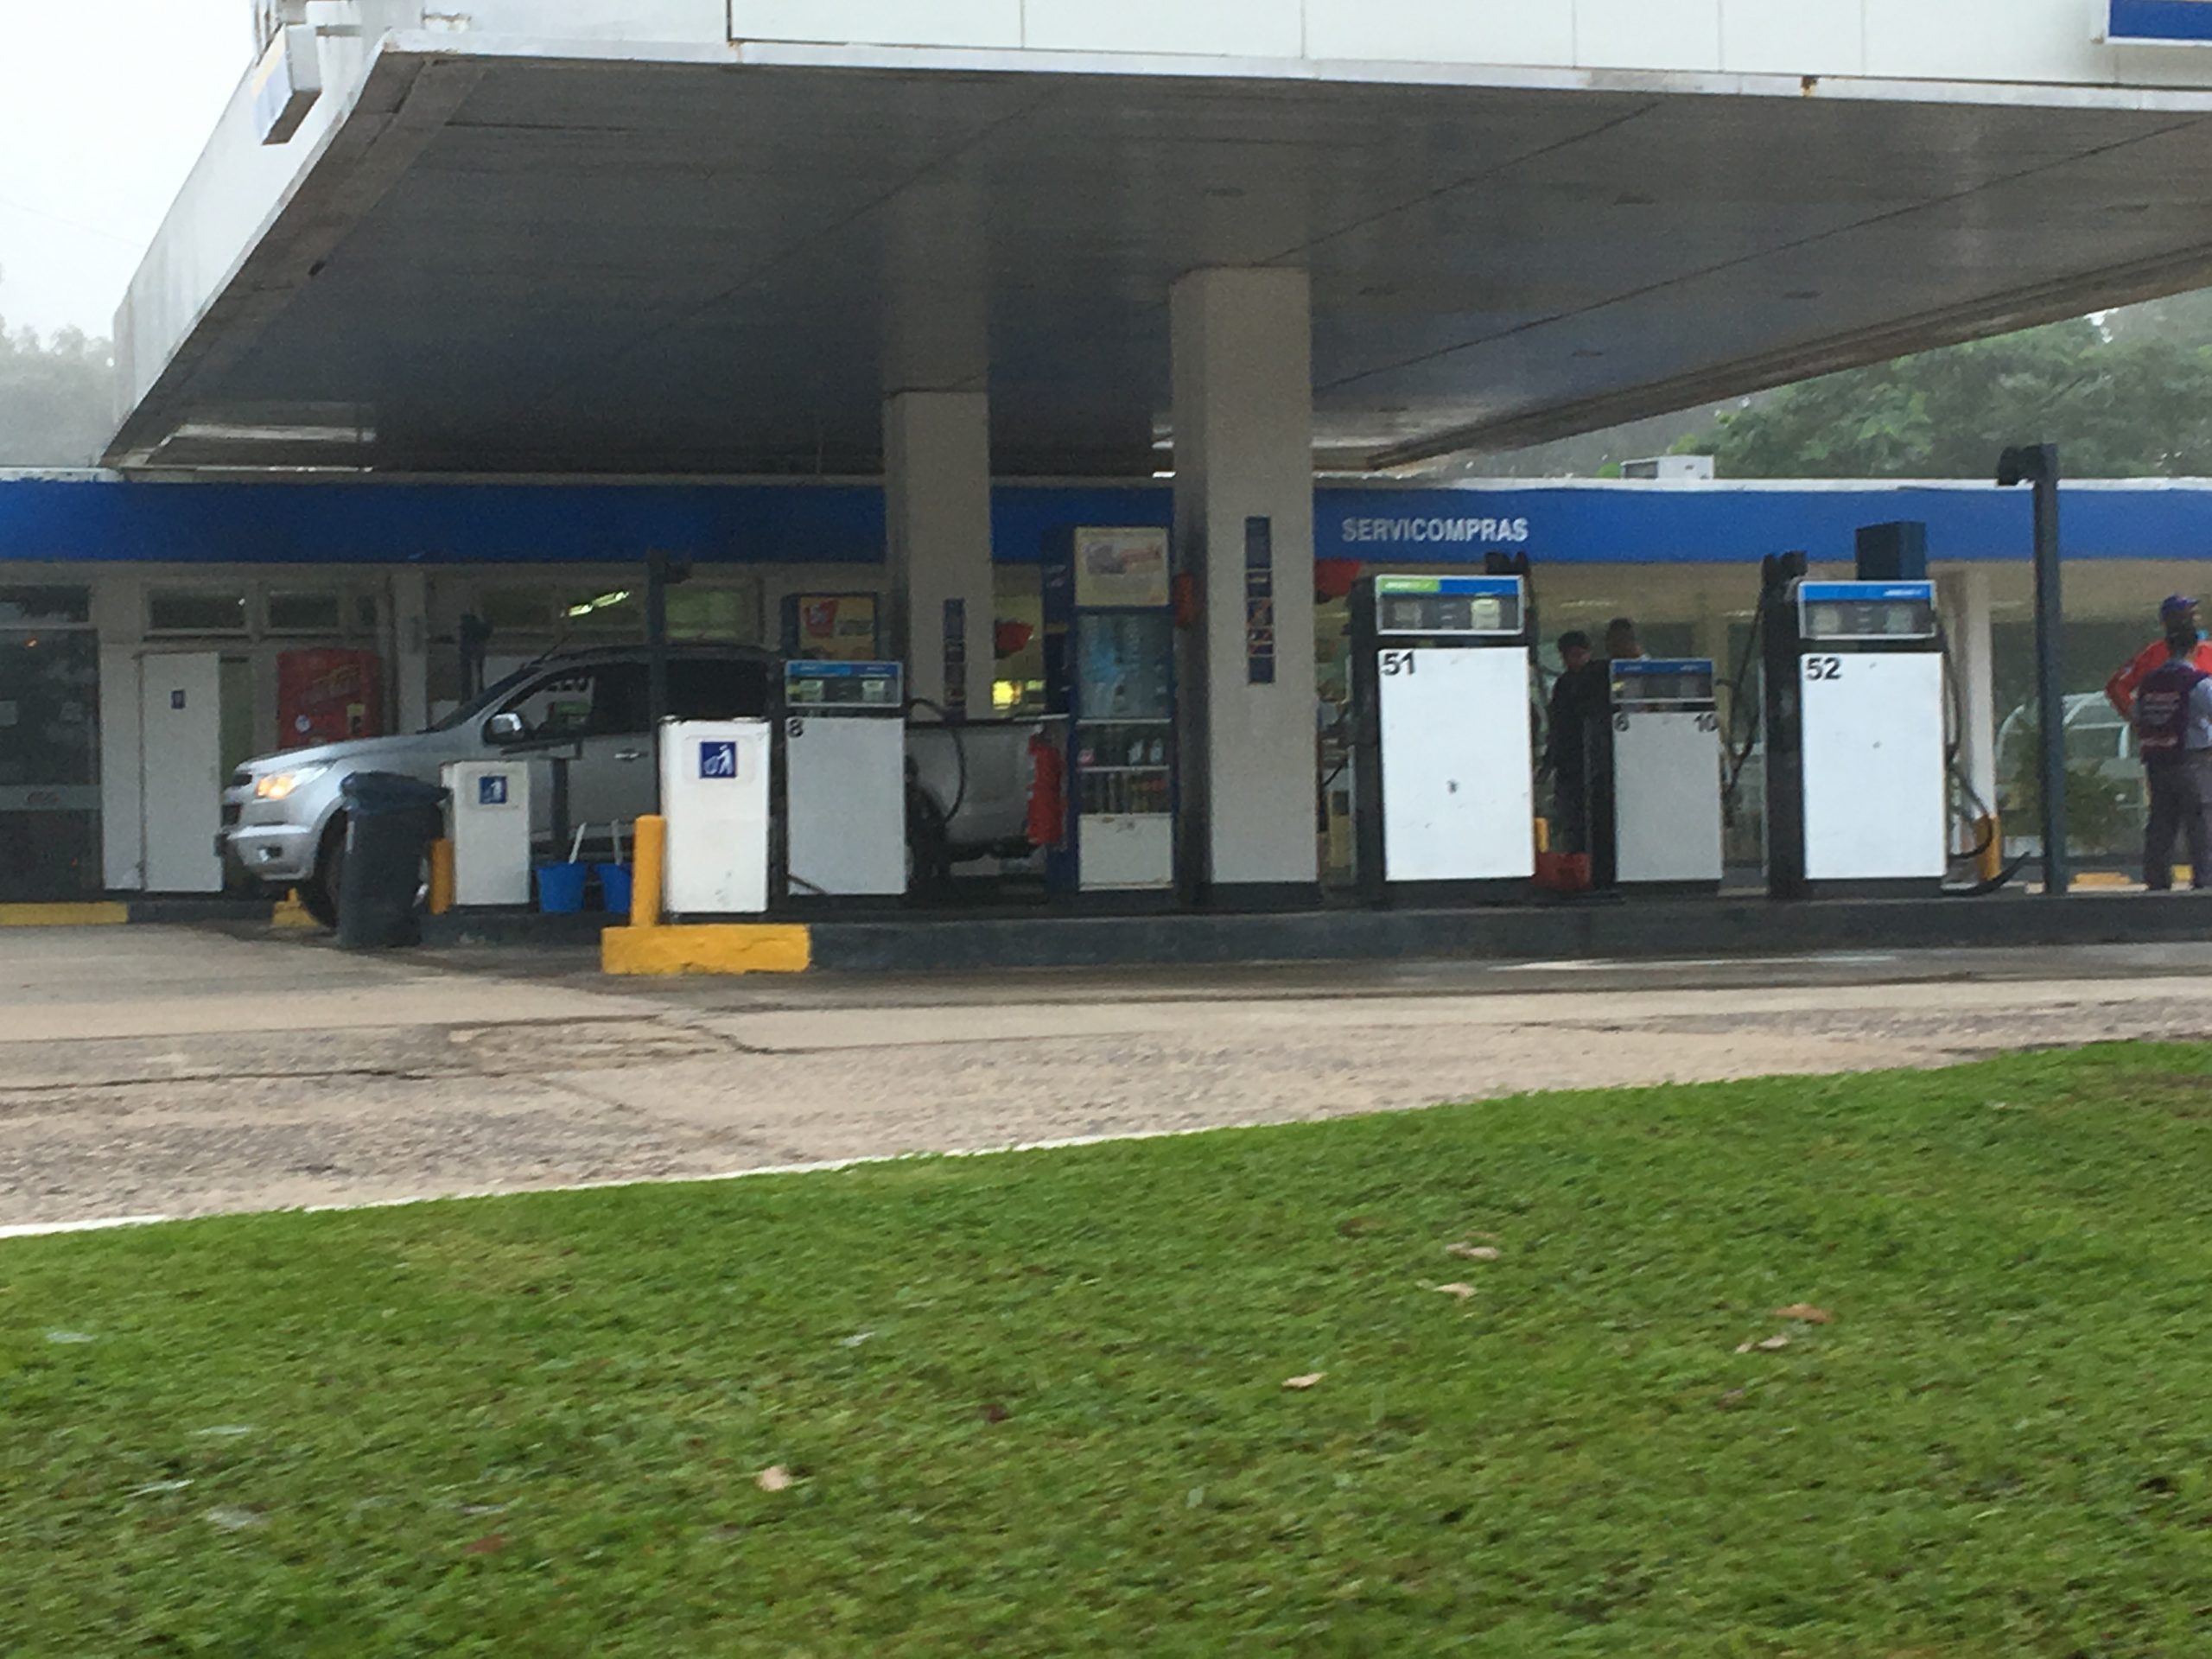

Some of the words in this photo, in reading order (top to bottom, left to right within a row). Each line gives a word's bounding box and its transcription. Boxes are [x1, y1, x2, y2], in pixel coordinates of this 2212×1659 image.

[1341, 518, 1529, 542] SERVICOMPRAS
[1382, 652, 1414, 676] 51
[1806, 657, 1842, 681] 52
[787, 718, 804, 738] 8
